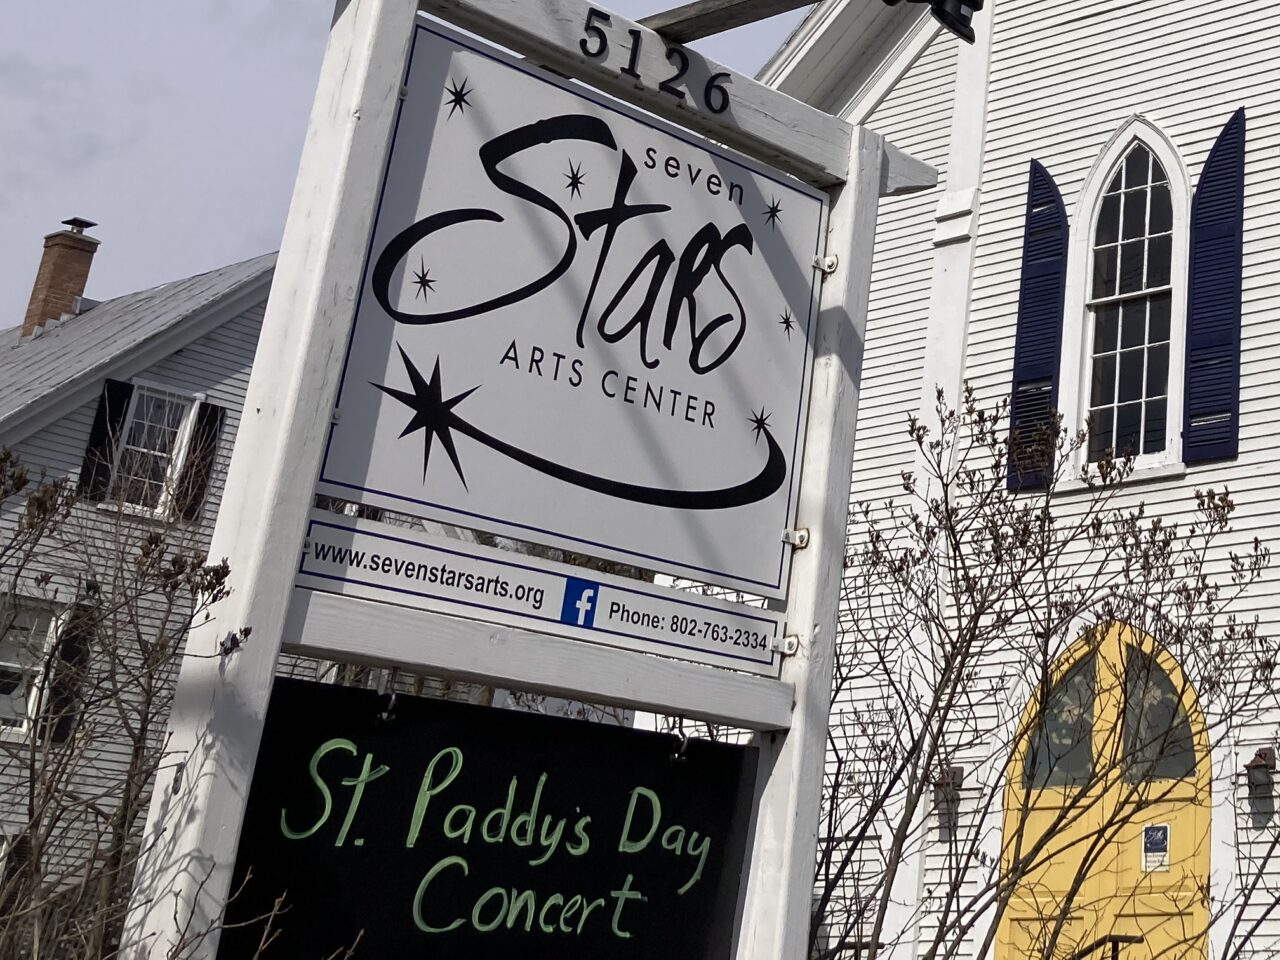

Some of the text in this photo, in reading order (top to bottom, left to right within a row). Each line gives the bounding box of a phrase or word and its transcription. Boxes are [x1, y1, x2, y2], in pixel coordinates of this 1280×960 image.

[578, 6, 732, 115] 5126
[643, 146, 744, 206] seven
[500, 339, 716, 429] ARTS CENTER
[313, 540, 545, 610] www.sevenstarsarts.org
[608, 600, 666, 632] Phone:
[669, 613, 769, 653] 802-763-2334
[280, 737, 391, 848] St.
[618, 785, 712, 895] Day
[412, 855, 648, 938] Concert
